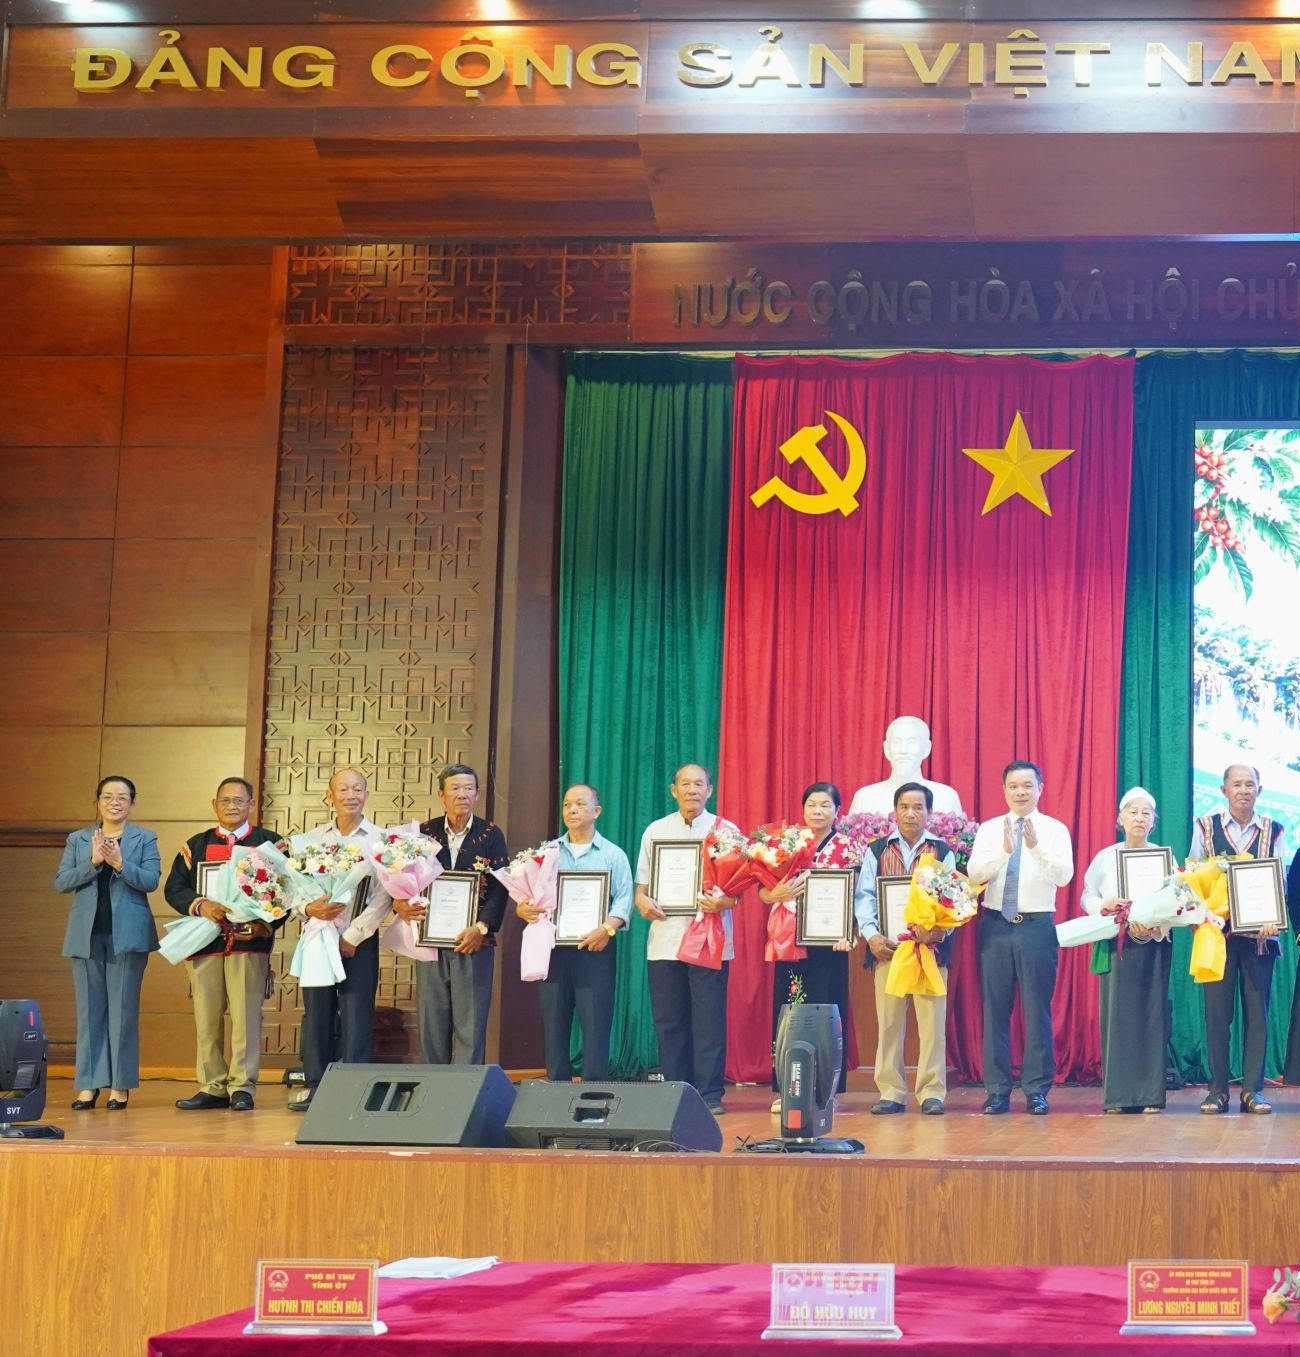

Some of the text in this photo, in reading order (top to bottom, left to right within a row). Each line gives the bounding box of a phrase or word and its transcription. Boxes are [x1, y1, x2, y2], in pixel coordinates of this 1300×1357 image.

[72, 30, 335, 92] ĐẢNG
[371, 31, 642, 97] CỘNG
[676, 26, 865, 88] SẢN
[902, 29, 1111, 97] VIỆT
[671, 268, 794, 327] NƯỚC
[807, 269, 932, 331] CỘNG
[949, 266, 1041, 323] HÒA
[1126, 266, 1200, 330] HỘI
[1215, 262, 1300, 321] CHỦ
[6, 1106, 21, 1115] SVT
[300, 1299, 314, 1316] THỊ
[848, 1305, 877, 1320] HUY
